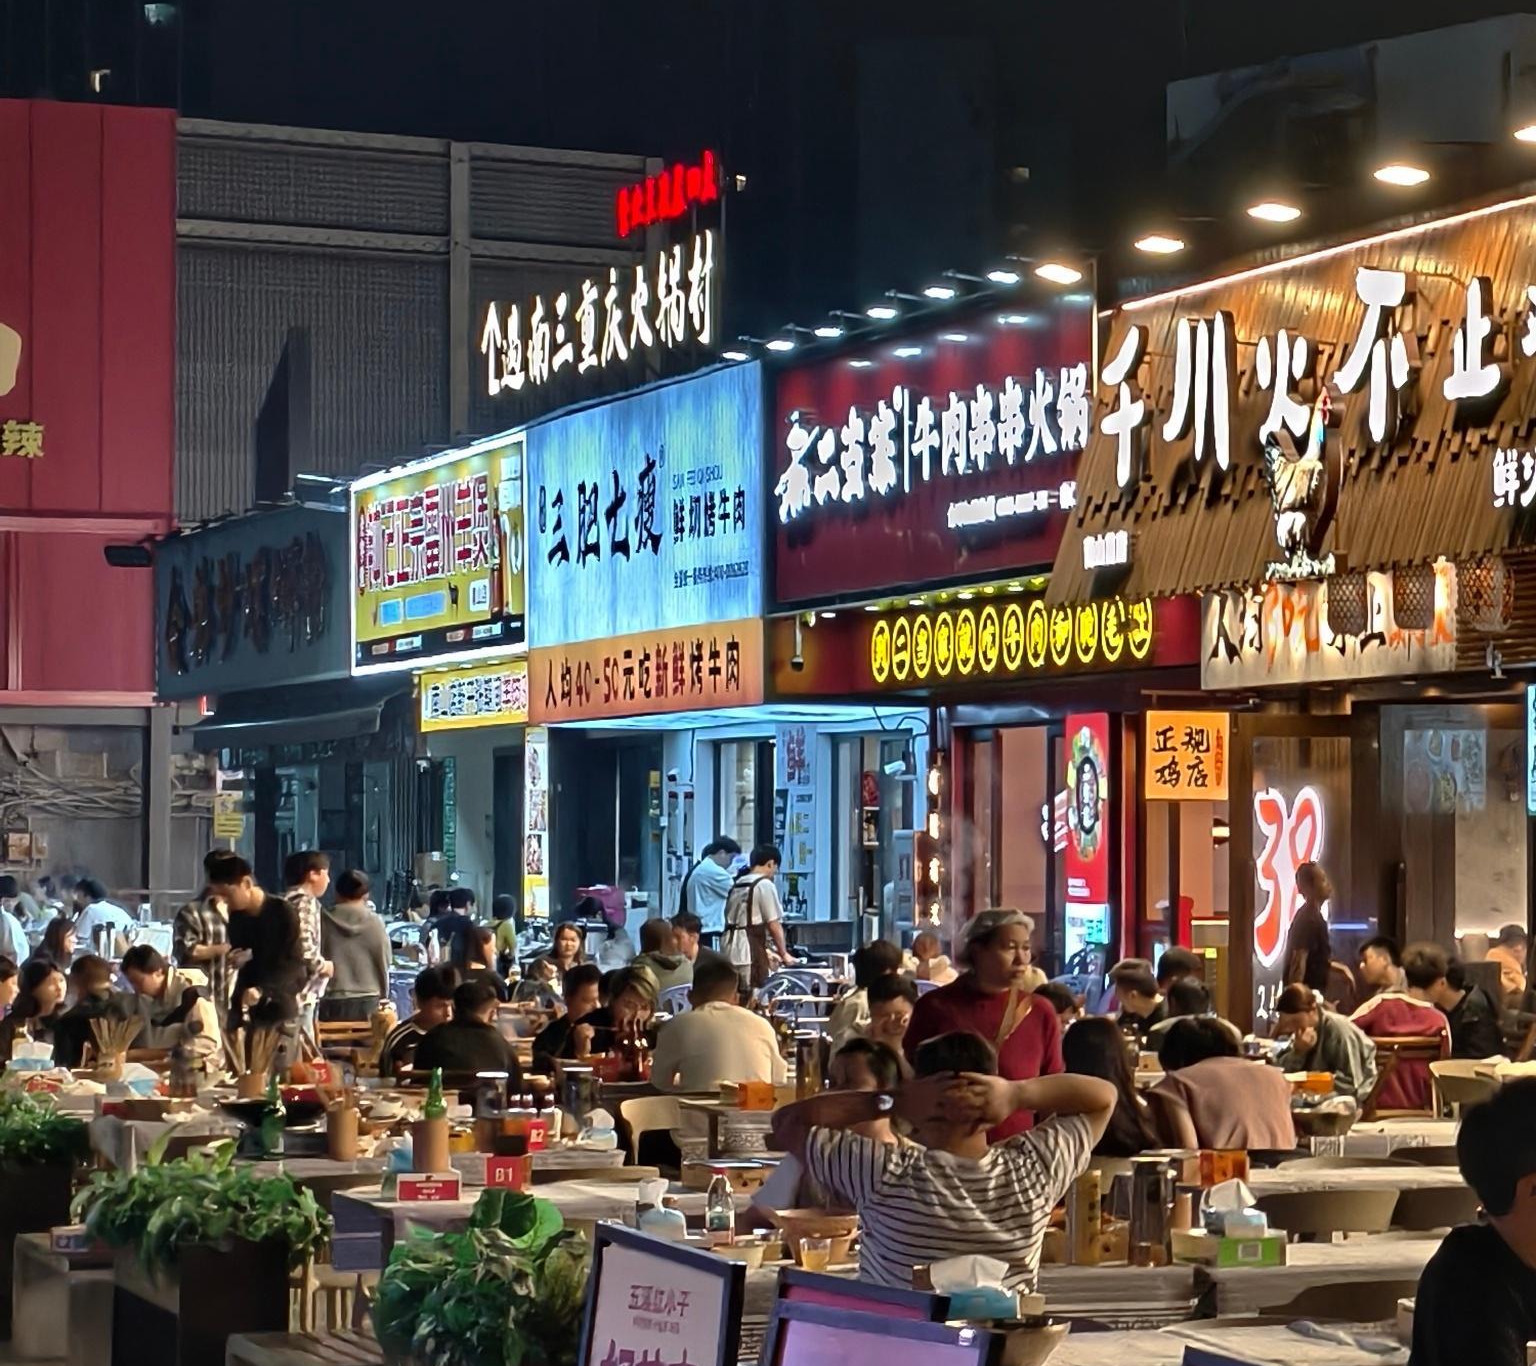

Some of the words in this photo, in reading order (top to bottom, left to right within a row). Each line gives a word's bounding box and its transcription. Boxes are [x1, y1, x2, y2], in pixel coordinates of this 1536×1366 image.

[911, 363, 1088, 481] 牛肉串串火锅
[545, 635, 741, 709] 人均40-50元吃新鲜烤牛肉
[1151, 725, 1211, 755] 正规
